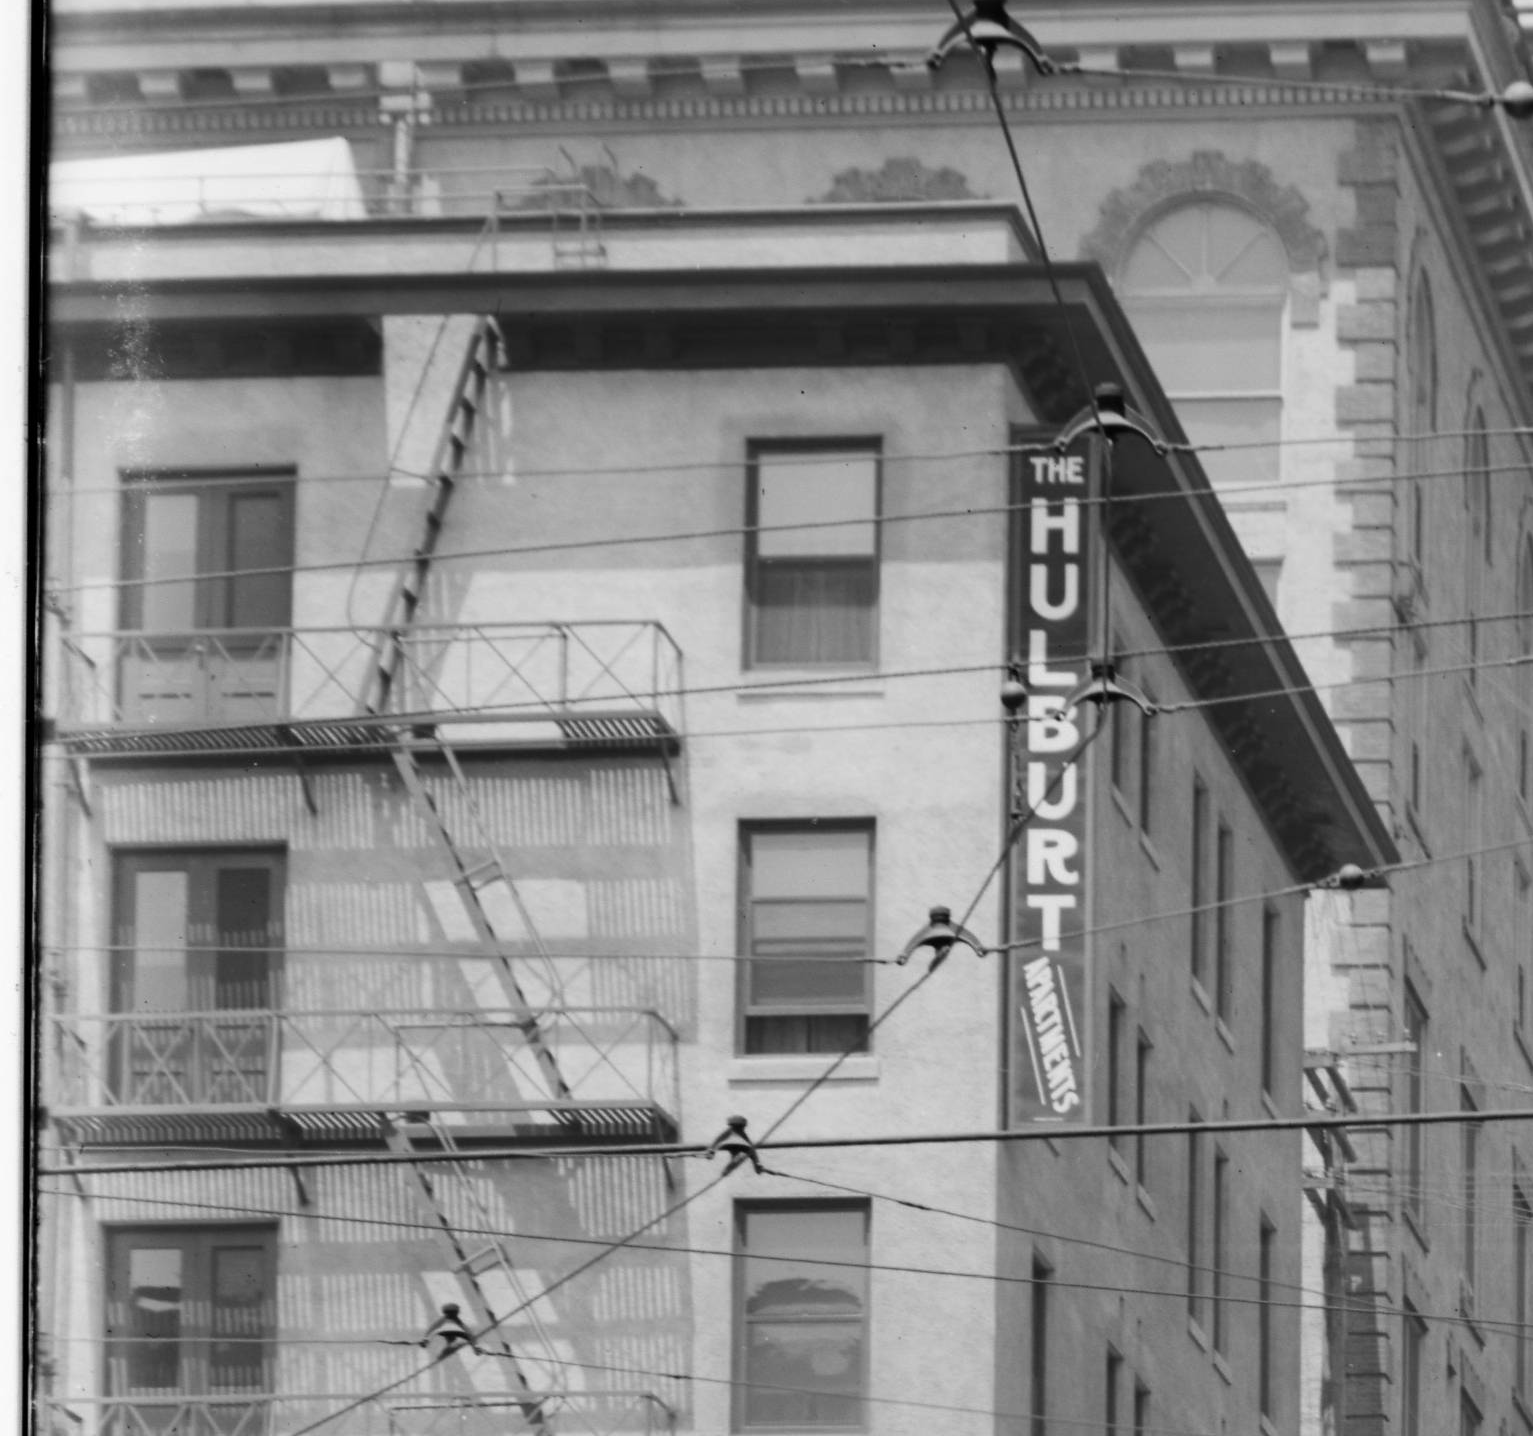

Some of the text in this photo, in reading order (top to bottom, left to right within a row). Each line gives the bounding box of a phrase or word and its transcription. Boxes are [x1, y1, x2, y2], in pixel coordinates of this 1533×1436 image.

[1030, 456, 1084, 485] THE
[1025, 496, 1081, 952] HULBURT
[1022, 956, 1082, 1115] APARTMENTS
